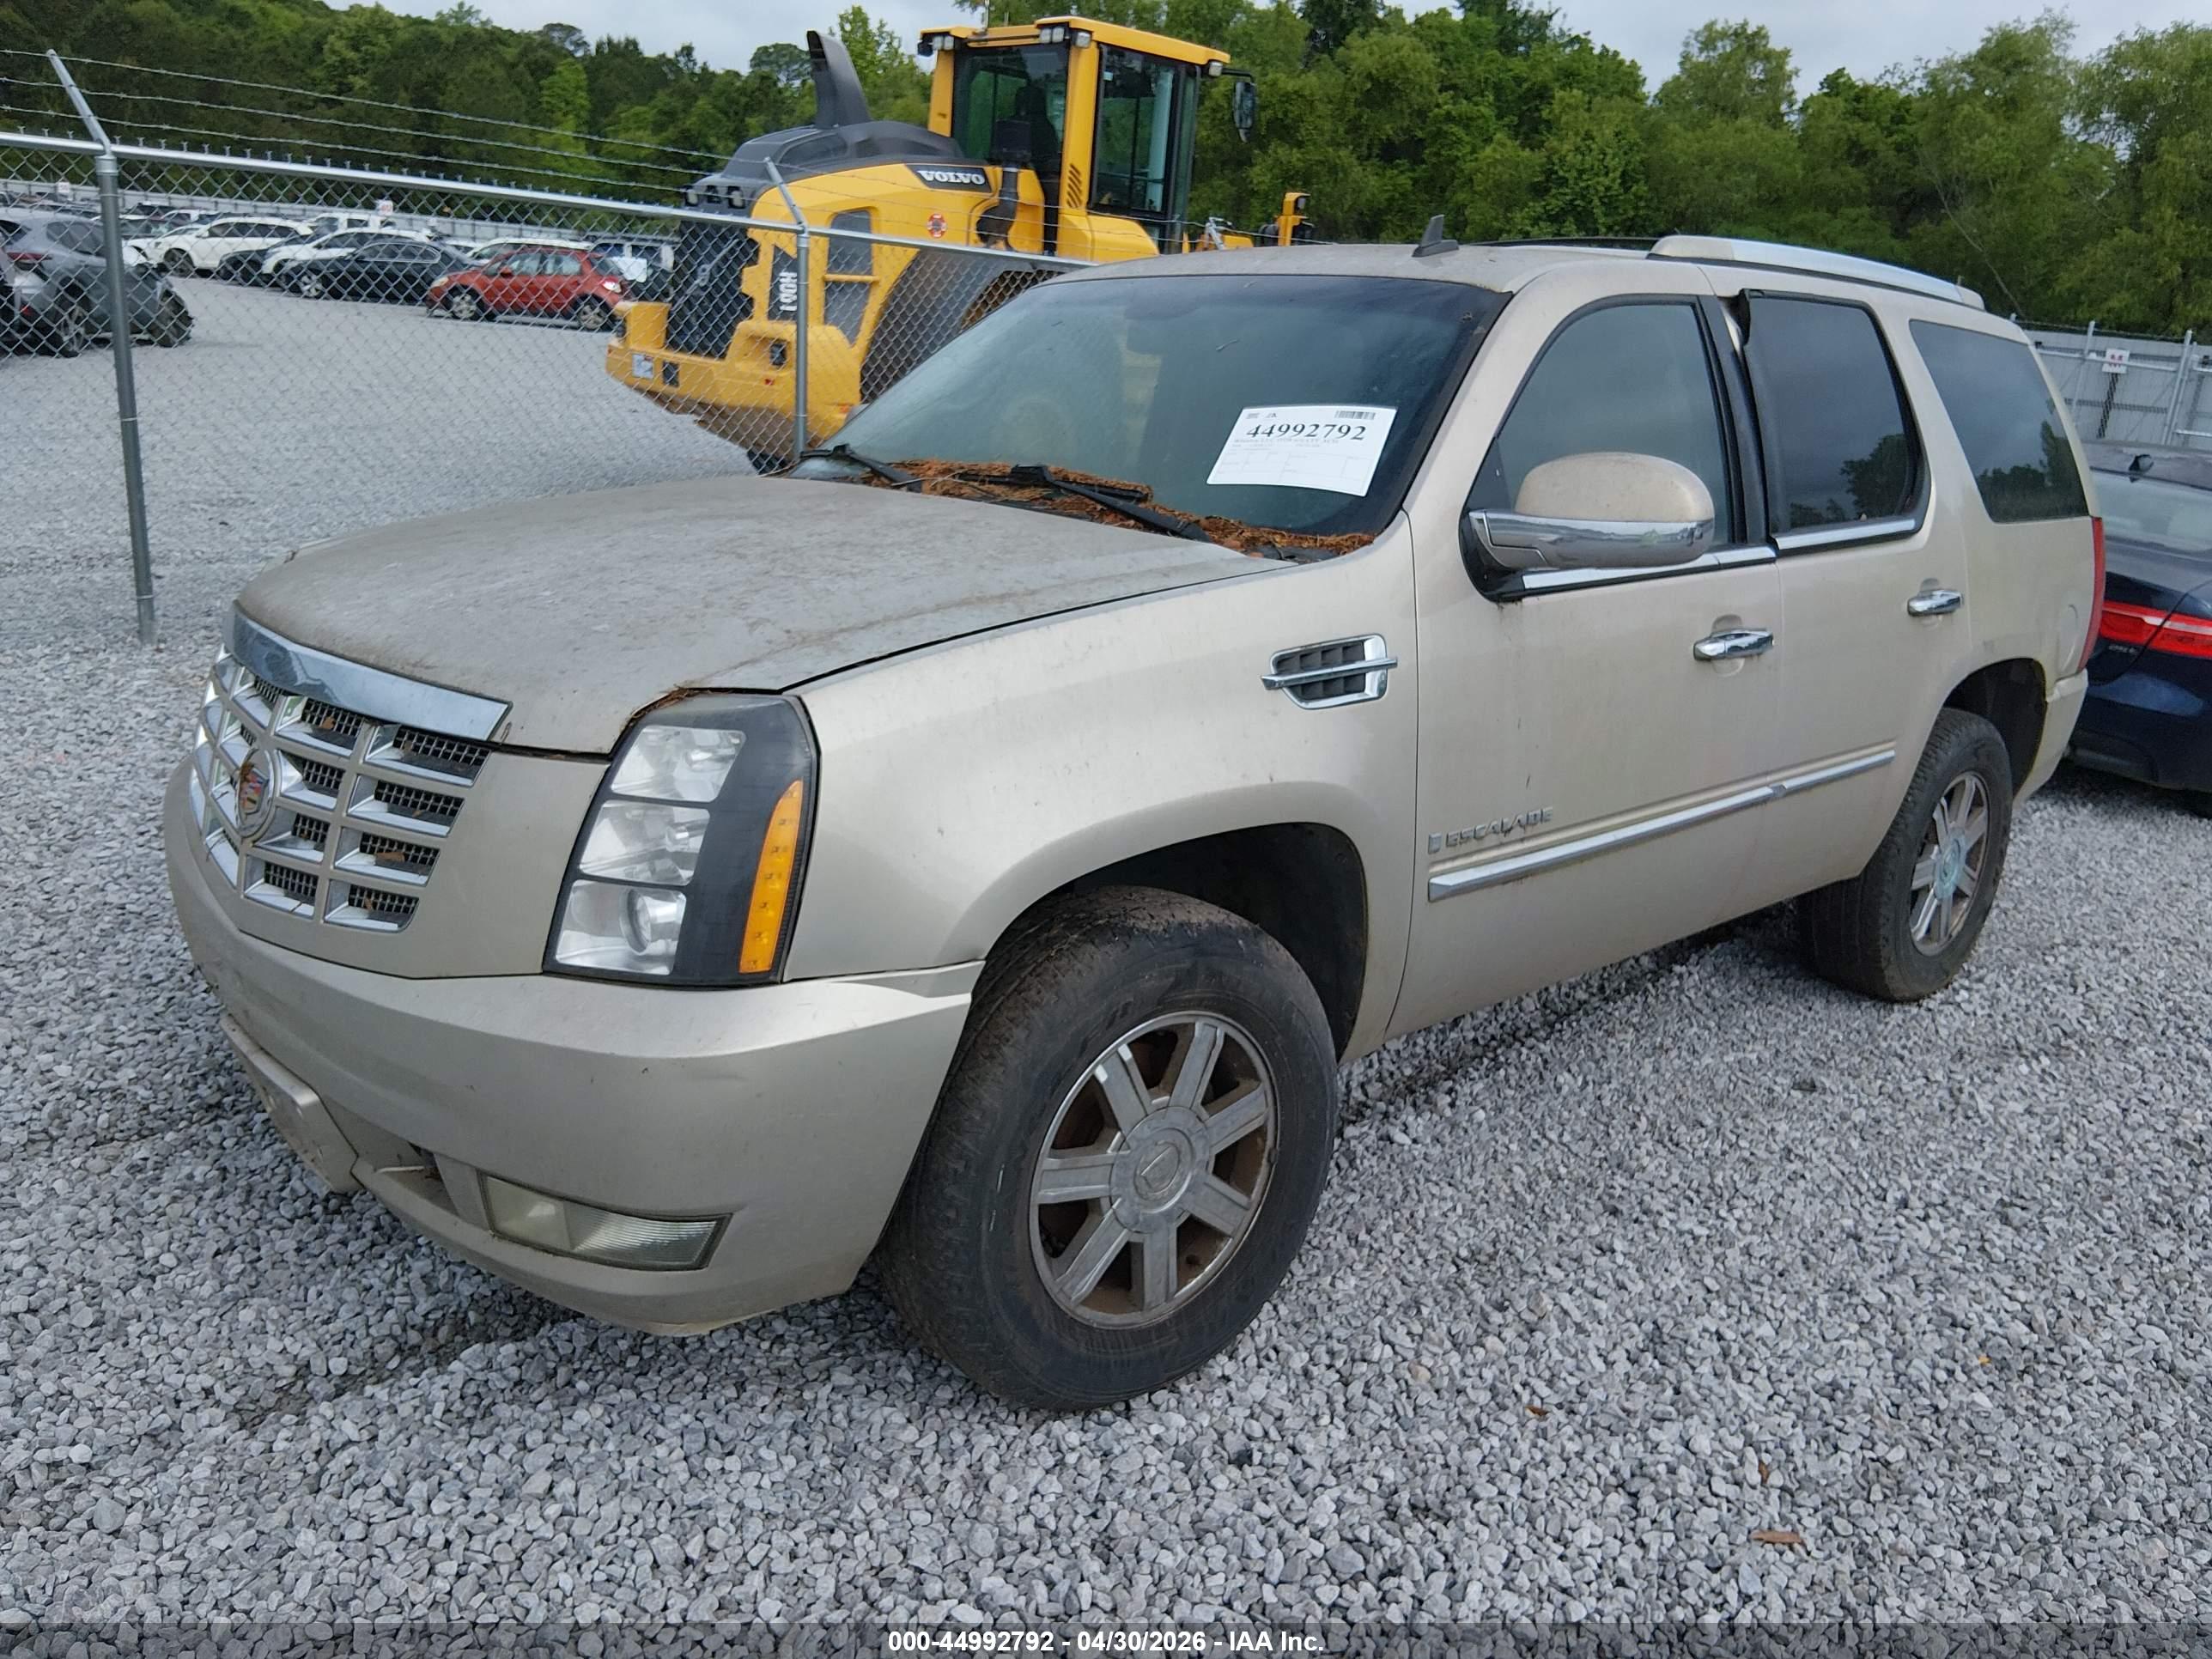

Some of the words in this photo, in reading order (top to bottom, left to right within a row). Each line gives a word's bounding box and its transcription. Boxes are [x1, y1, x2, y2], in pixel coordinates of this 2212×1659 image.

[916, 170, 985, 185] VOLVO
[1246, 423, 1366, 441] 44992792
[1446, 806, 1553, 847] ESCALADE
